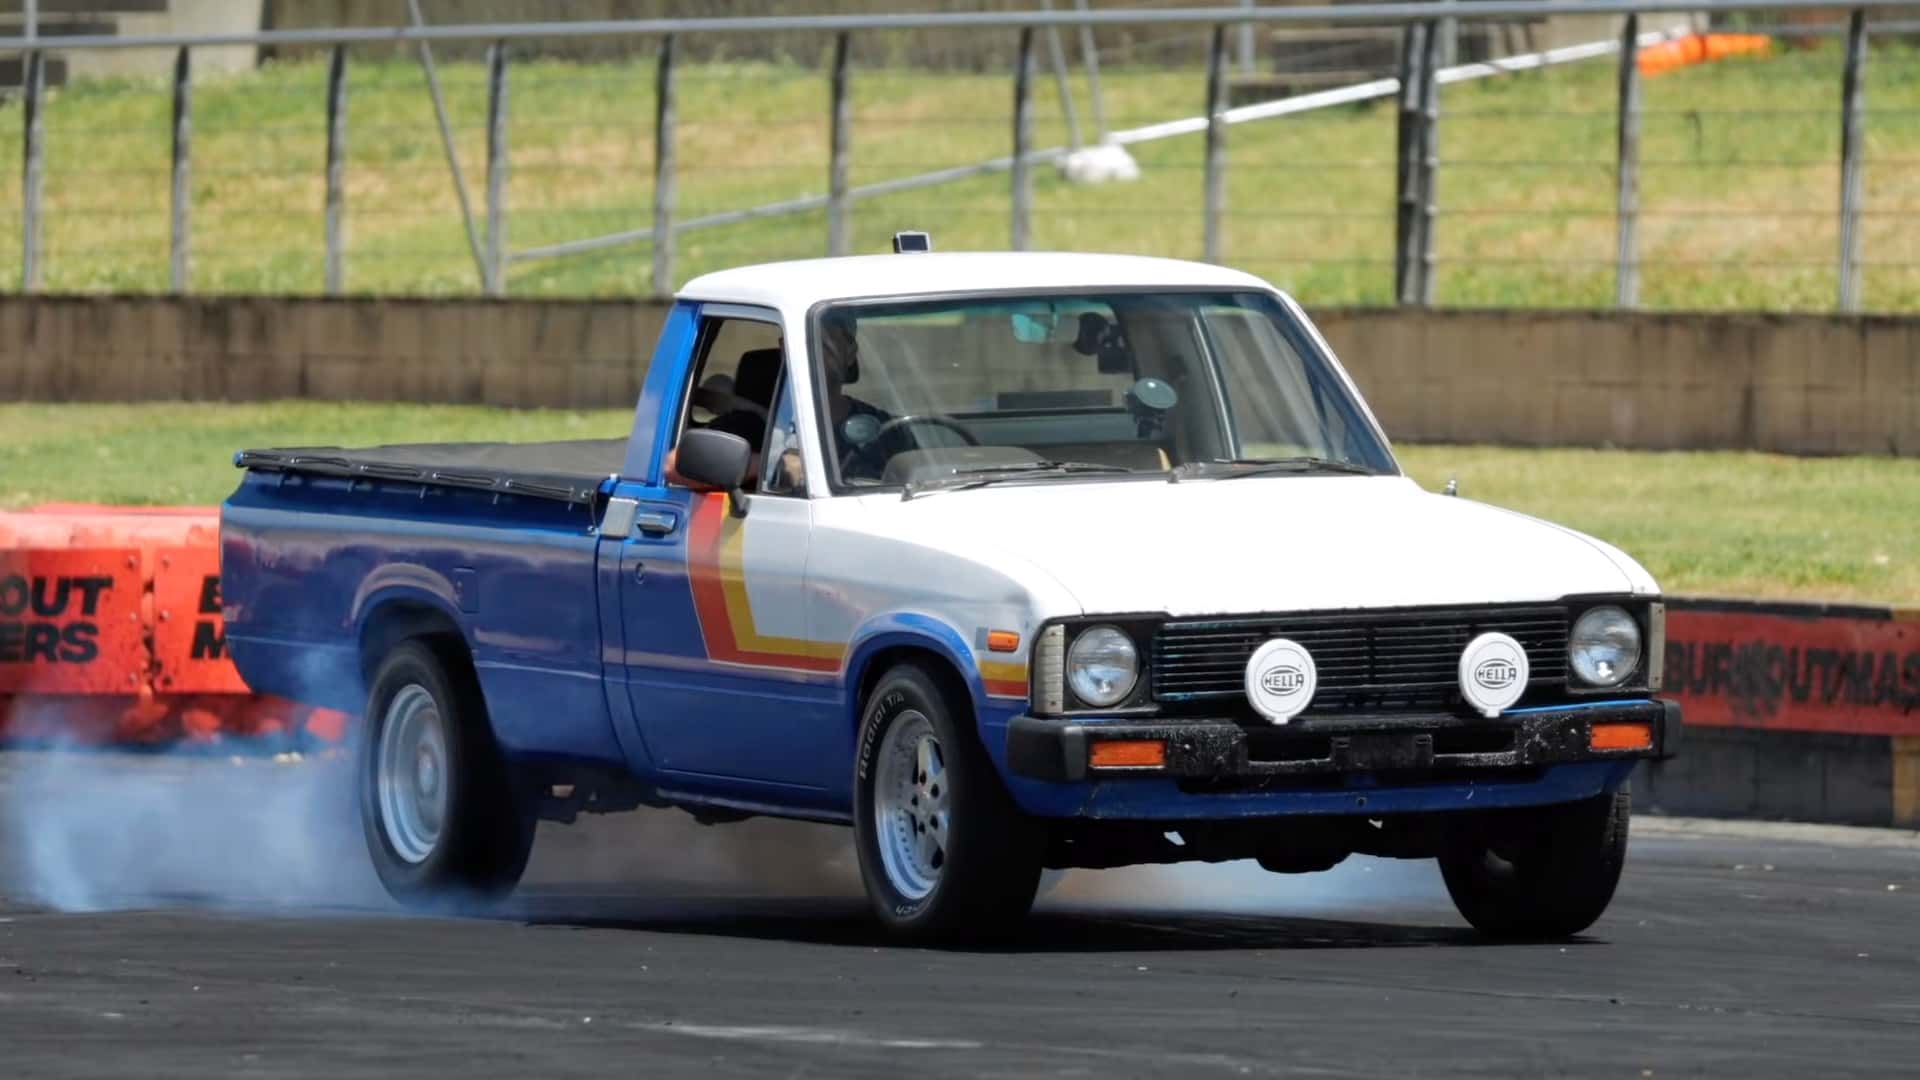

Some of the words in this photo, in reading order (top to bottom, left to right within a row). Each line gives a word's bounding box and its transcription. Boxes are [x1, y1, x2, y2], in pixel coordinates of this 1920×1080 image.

[1264, 673, 1304, 688] HELLA
[1478, 667, 1517, 681] HELLA
[860, 703, 886, 780] Radial
